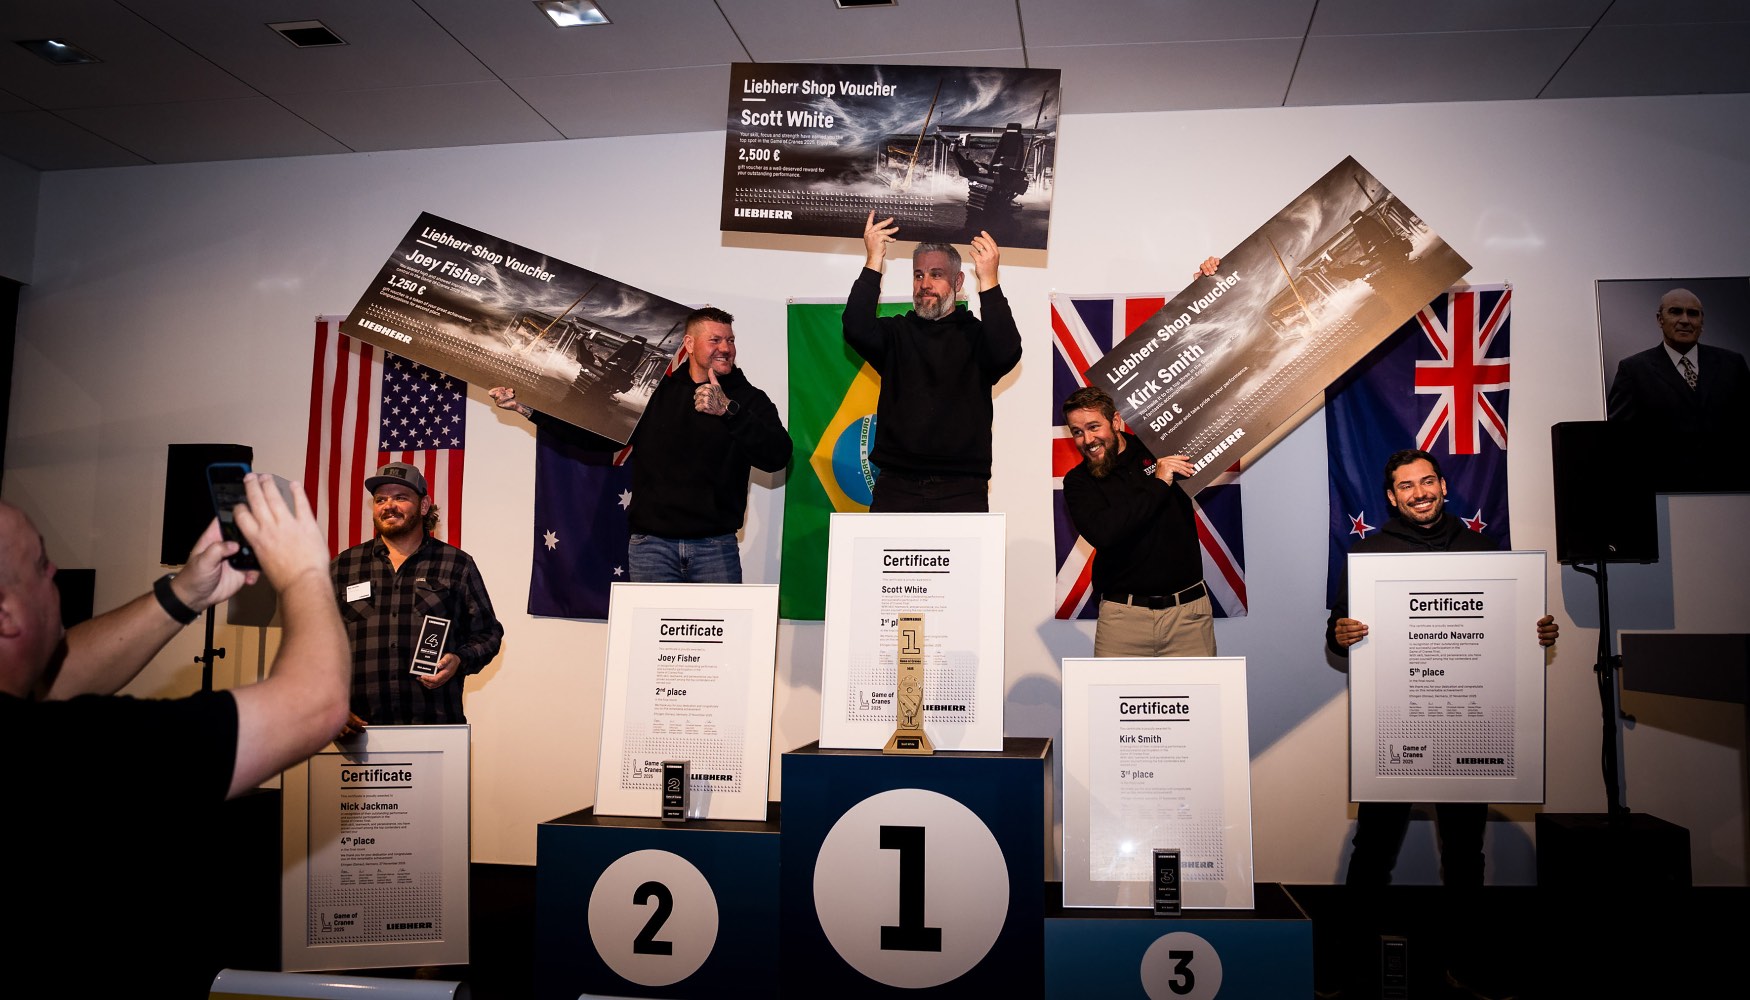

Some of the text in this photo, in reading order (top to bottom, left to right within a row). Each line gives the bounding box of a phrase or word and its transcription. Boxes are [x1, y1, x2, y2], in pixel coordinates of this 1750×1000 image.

[743, 78, 896, 97] Liebherr Shop Voucher
[740, 109, 834, 128] Scott White
[738, 148, 780, 162] 2,500 €
[734, 208, 792, 219] LIEBHERR
[421, 227, 555, 282] Liebherr Shop Voucher
[406, 250, 486, 286] Joey Fisher
[388, 274, 426, 295] 1,250 €
[358, 318, 412, 344] LIEBHERR
[1106, 338, 1159, 384] Liebherr
[1157, 313, 1191, 341] Shop
[1187, 270, 1241, 314] Voucher
[1126, 380, 1162, 410] Kirk
[1158, 345, 1205, 383] Smith
[1150, 403, 1182, 431] 500 €
[883, 554, 950, 567] Certificate
[1409, 598, 1484, 611] Certificate
[660, 624, 723, 636] Certificate
[1409, 631, 1448, 640] Leonardo
[425, 633, 438, 647] 4
[902, 630, 920, 654] 1
[658, 654, 676, 663] Joey
[1410, 668, 1445, 677] 5th place
[667, 688, 687, 696] place
[1120, 702, 1189, 714] Certificate
[1120, 735, 1162, 743] Kirk Smith
[341, 770, 412, 782] Certificate
[1132, 770, 1154, 780] place
[668, 778, 680, 792] 2
[341, 802, 398, 810] Nick Jackman
[353, 837, 375, 846] place
[1161, 869, 1174, 883] 3
[878, 824, 942, 952] 1
[632, 880, 674, 956] 2
[1168, 950, 1195, 996] 3
